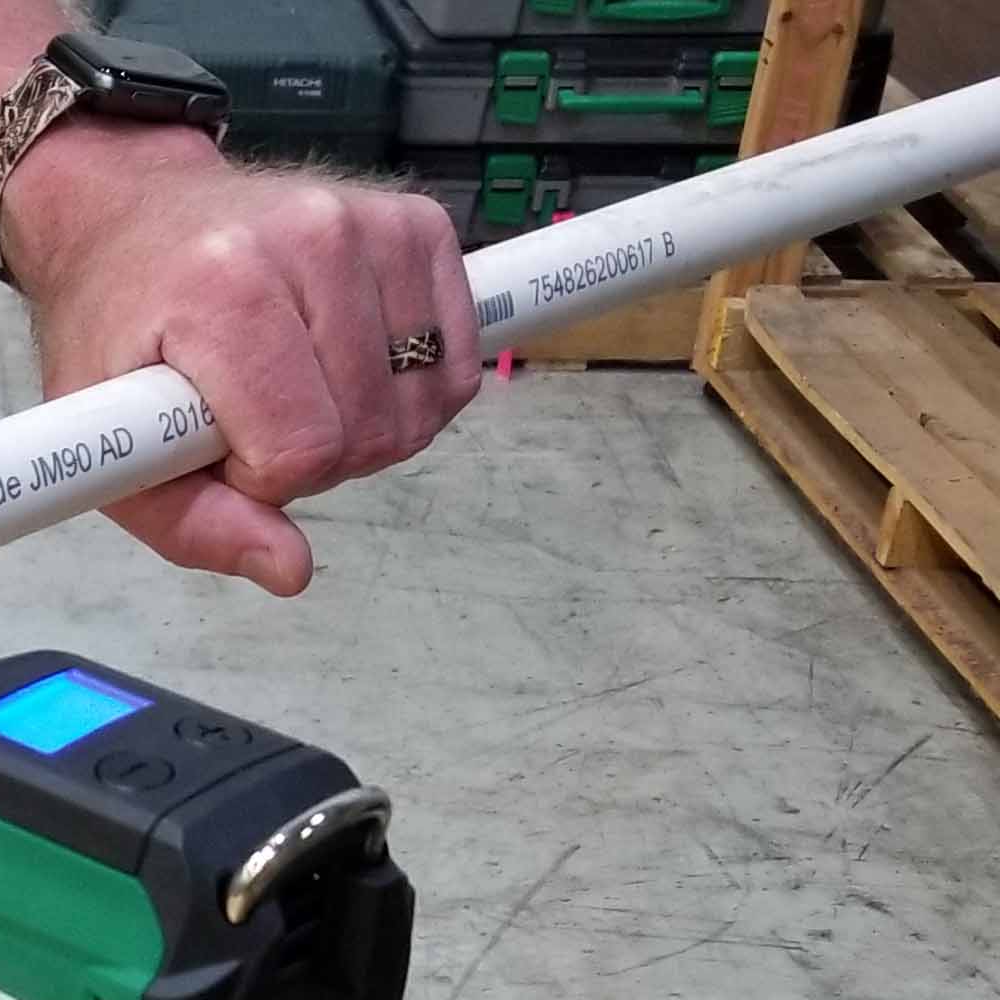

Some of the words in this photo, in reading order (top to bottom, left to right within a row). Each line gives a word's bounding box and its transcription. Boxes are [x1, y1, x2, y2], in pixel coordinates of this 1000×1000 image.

[528, 237, 653, 306] 754826200617
[662, 231, 676, 257] B
[30, 442, 93, 492] JM90
[100, 427, 134, 467] AD
